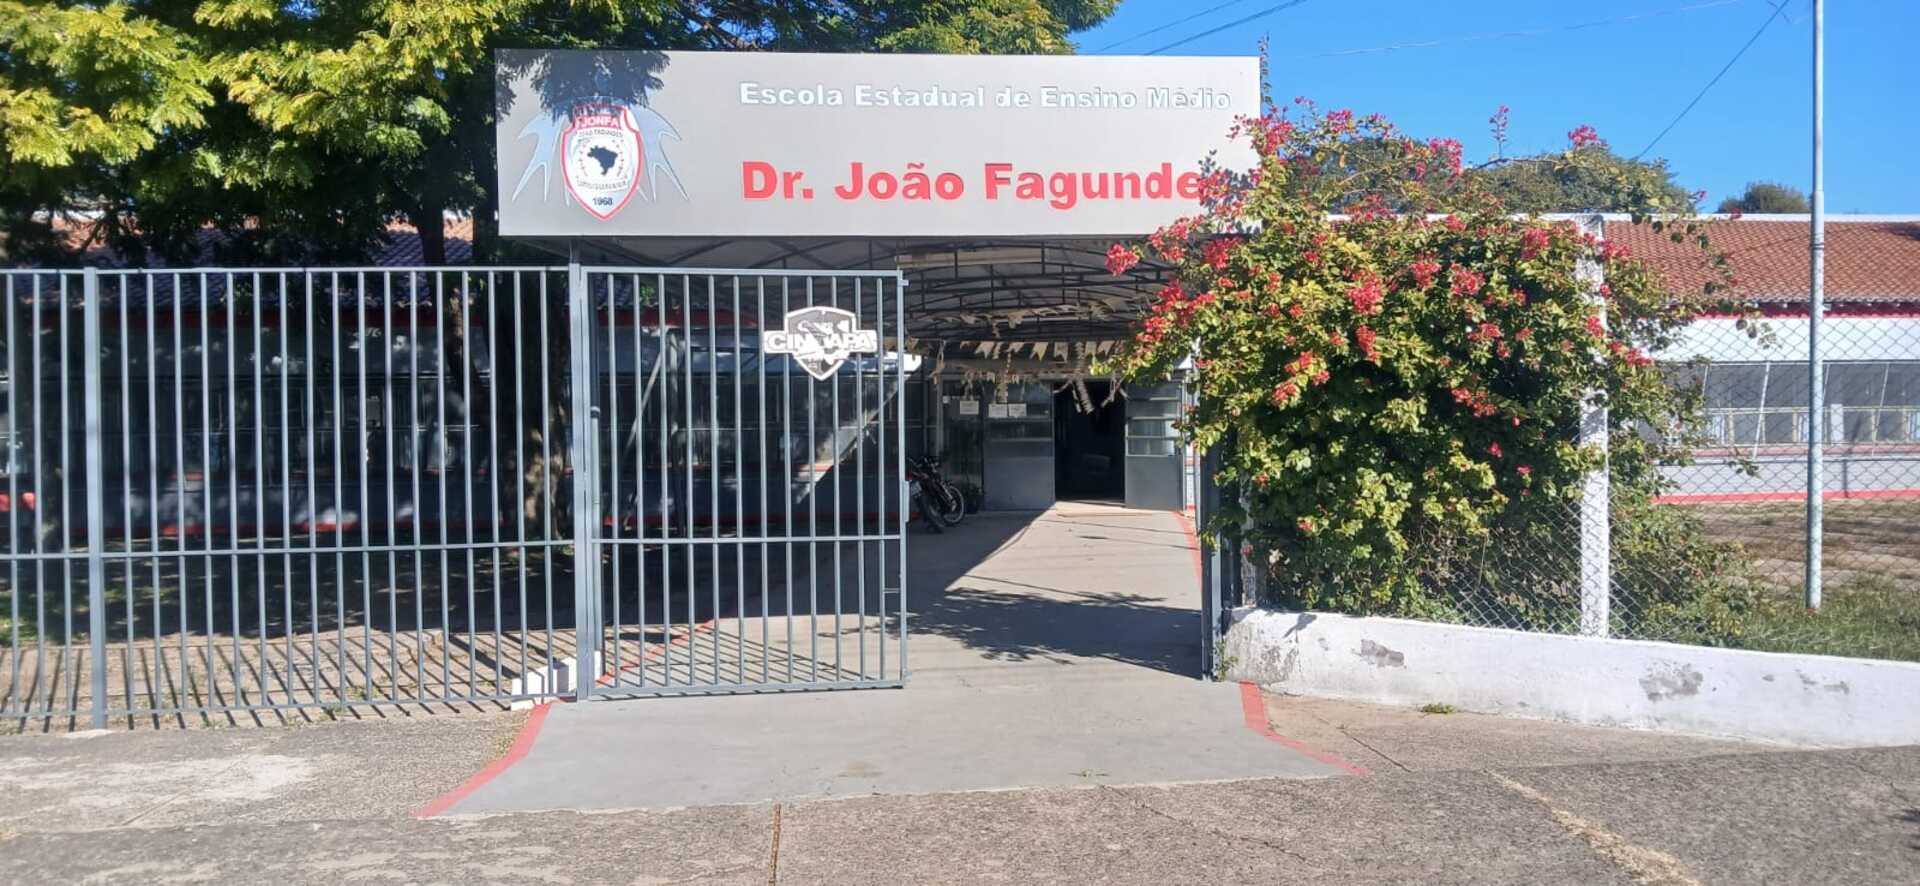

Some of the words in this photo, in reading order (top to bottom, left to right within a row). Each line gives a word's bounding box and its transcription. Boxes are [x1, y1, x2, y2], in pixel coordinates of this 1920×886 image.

[739, 82, 843, 105] Escola
[855, 84, 985, 107] Estadual
[995, 86, 1032, 108] de
[1040, 86, 1137, 109] Ensino
[1147, 87, 1232, 110] Médio
[742, 161, 815, 199] Dr.
[834, 162, 965, 200] João
[984, 162, 1202, 210] Fagunde
